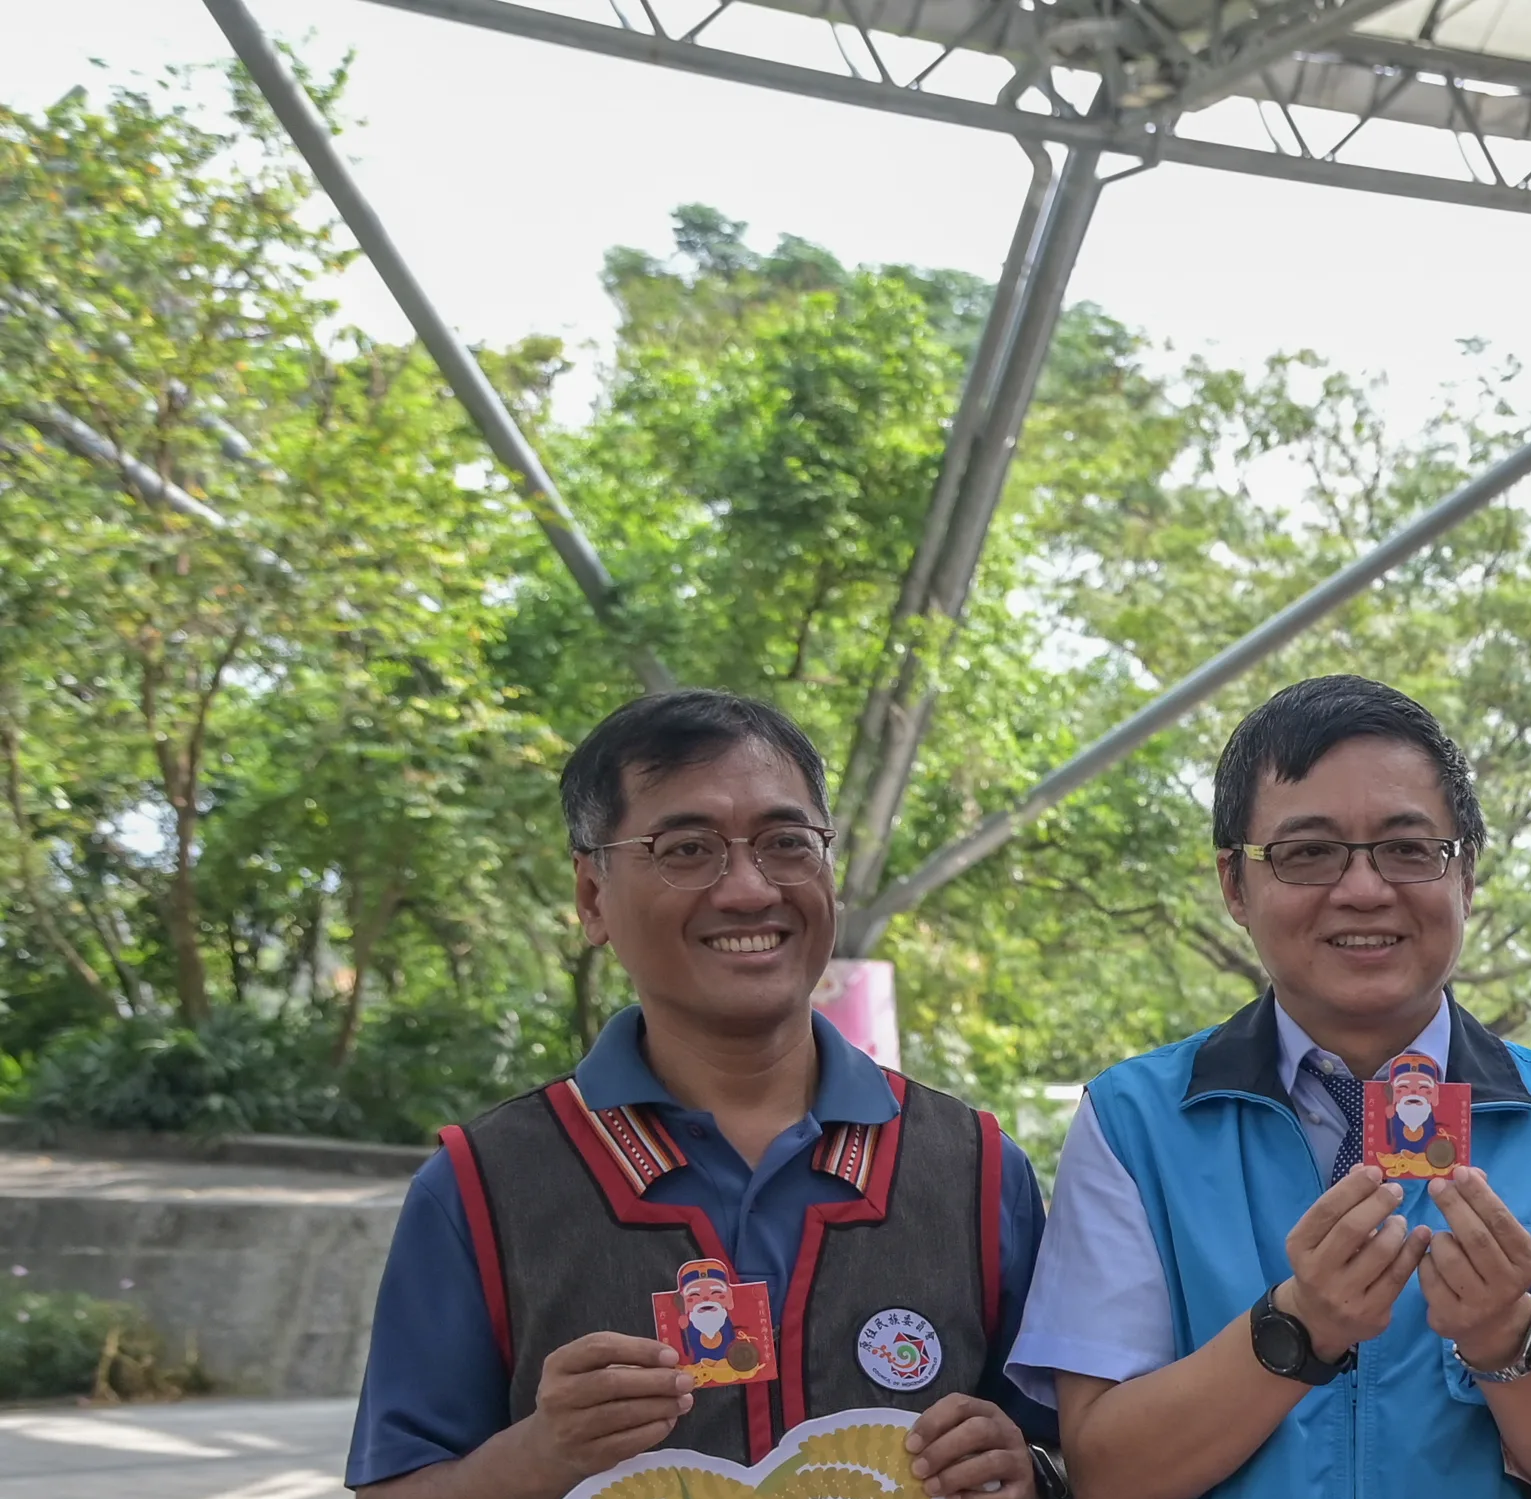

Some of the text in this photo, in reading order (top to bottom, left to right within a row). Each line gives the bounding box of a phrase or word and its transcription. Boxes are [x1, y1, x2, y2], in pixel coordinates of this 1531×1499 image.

[859, 1313, 936, 1353] 原住民族委員會
